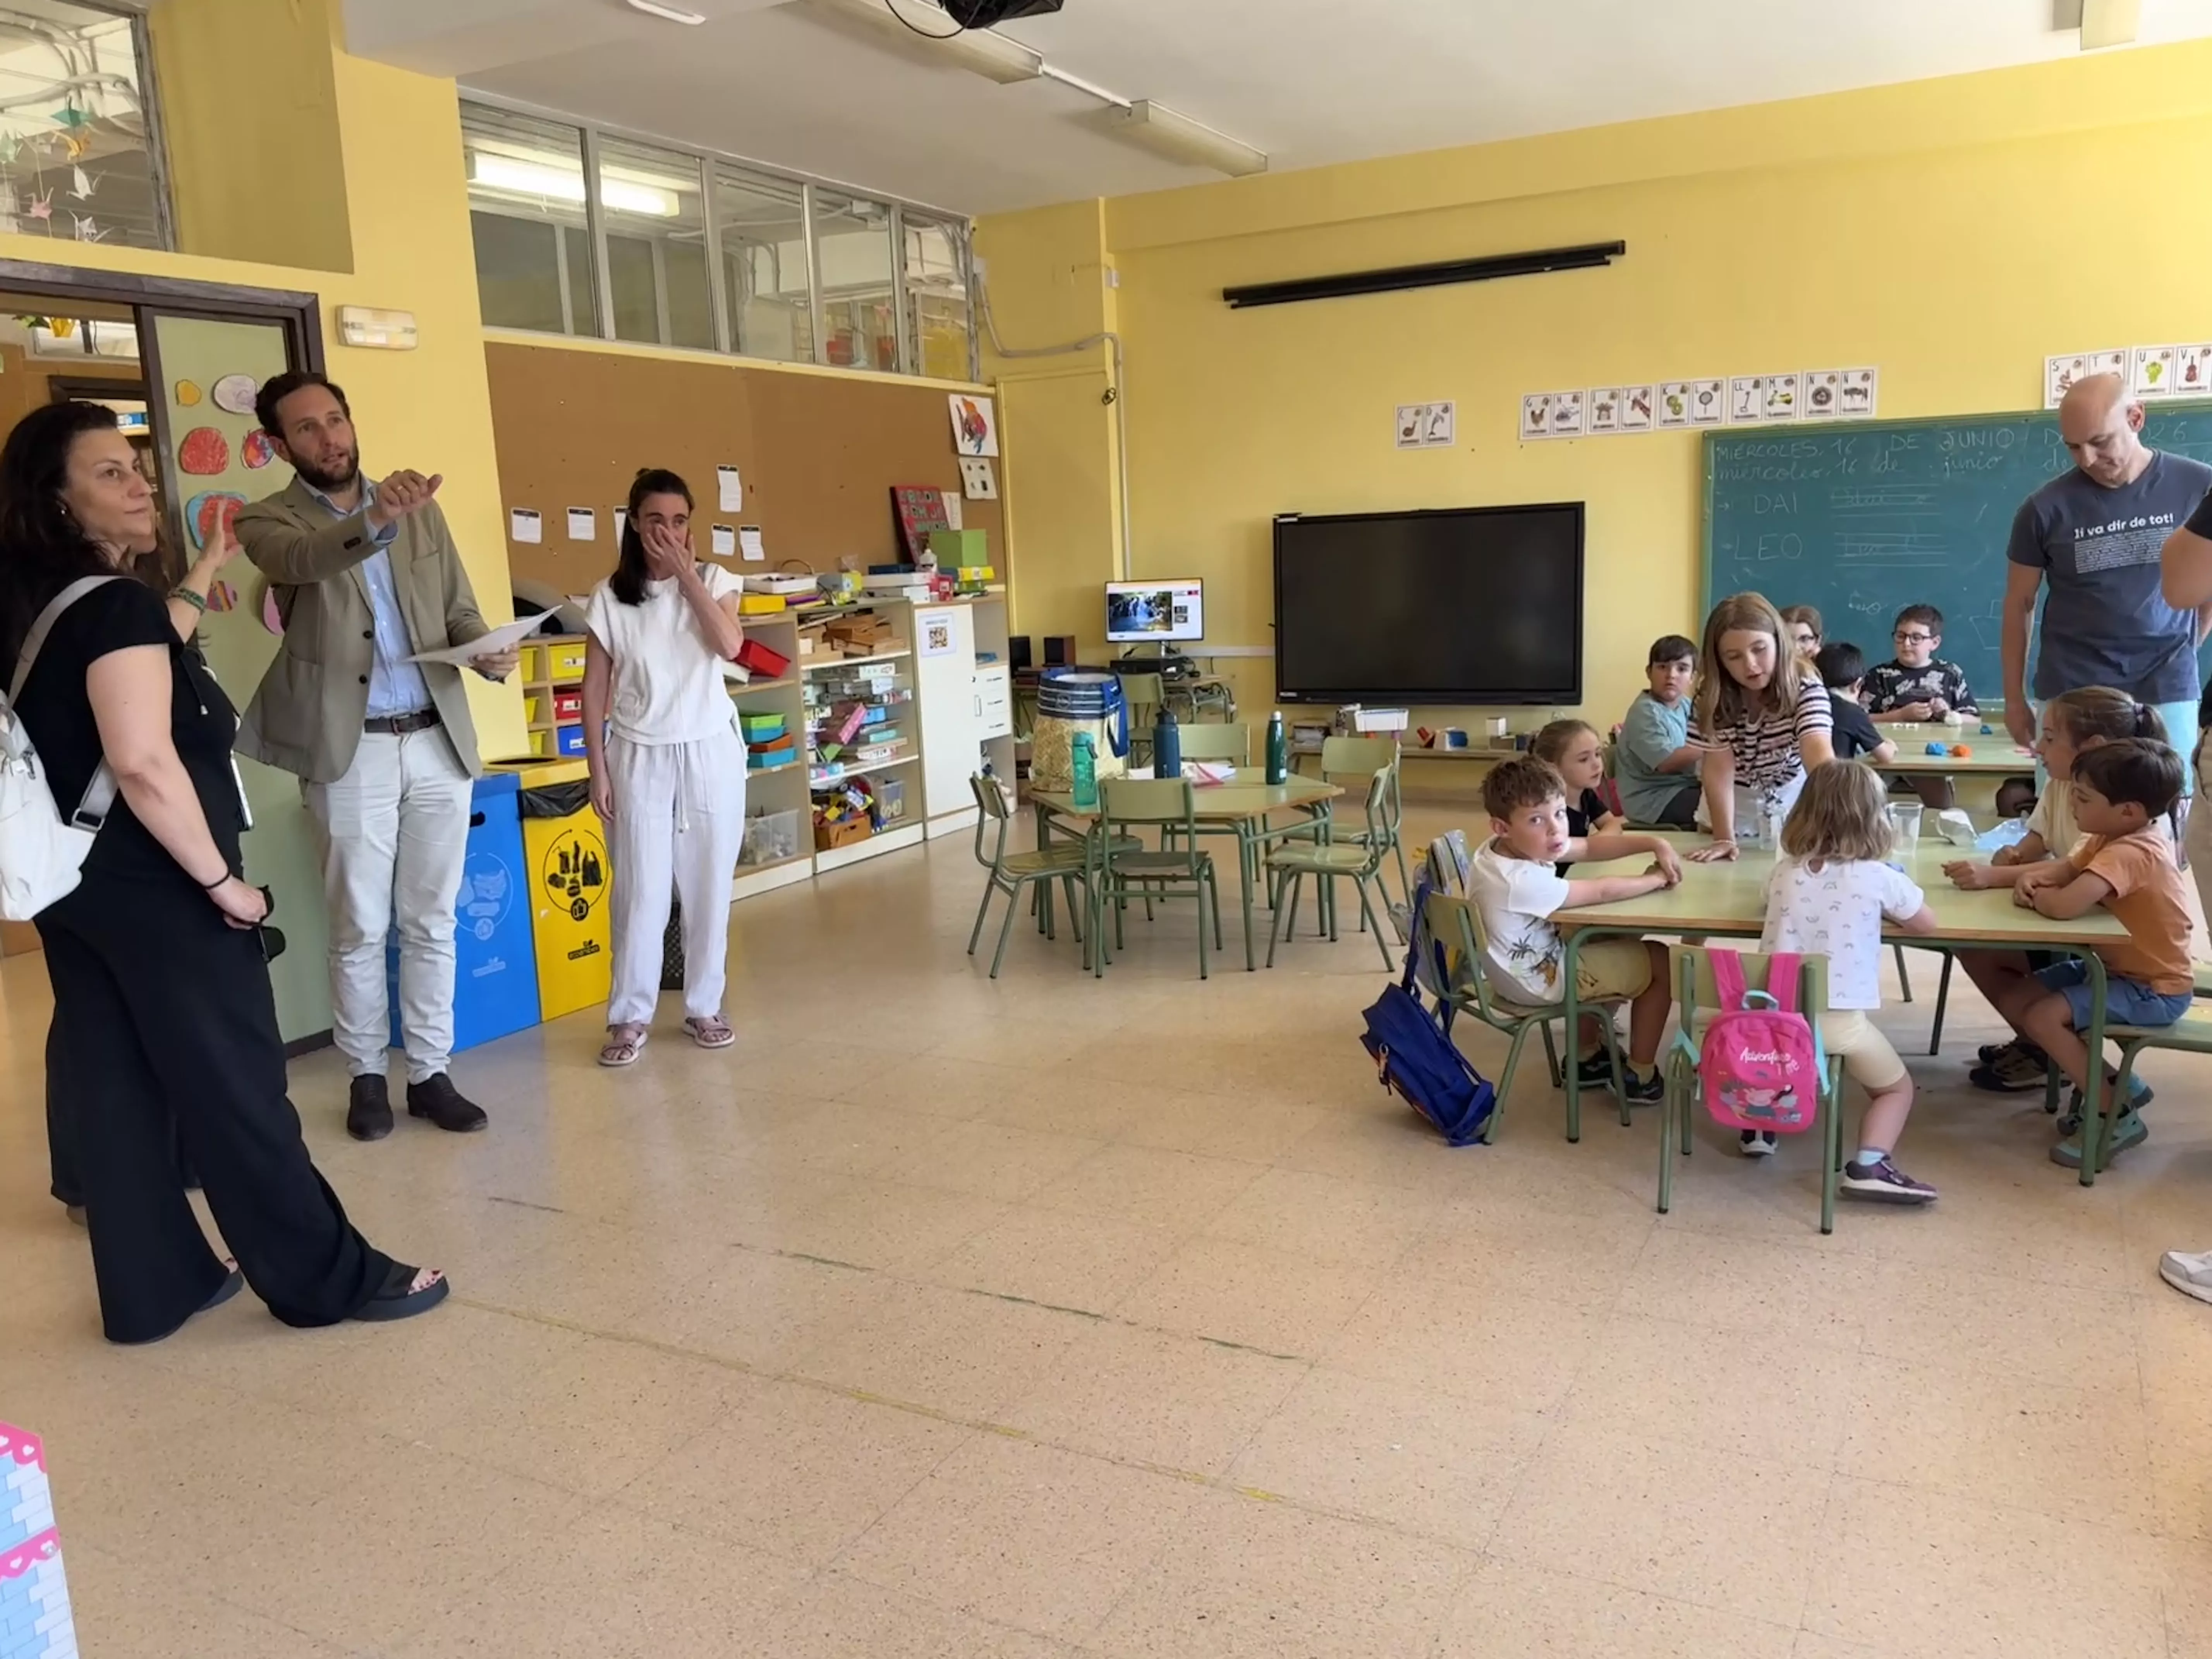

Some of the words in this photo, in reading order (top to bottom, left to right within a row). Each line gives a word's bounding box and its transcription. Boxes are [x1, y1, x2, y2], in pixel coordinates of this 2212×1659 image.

[2094, 357, 2099, 366] T
[2140, 352, 2146, 362] U
[2181, 349, 2187, 359] V
[2052, 361, 2059, 372] S
[1831, 437, 1856, 456] 16
[1890, 433, 1922, 451] DE
[1939, 428, 2014, 451] JUNIO
[2044, 428, 2063, 445] D
[1754, 492, 1798, 514] DAI
[2087, 526, 2104, 536] va
[2107, 519, 2126, 532] dir
[2129, 516, 2146, 528] de
[2149, 513, 2173, 524] tot!
[1735, 533, 1803, 560] LEO
